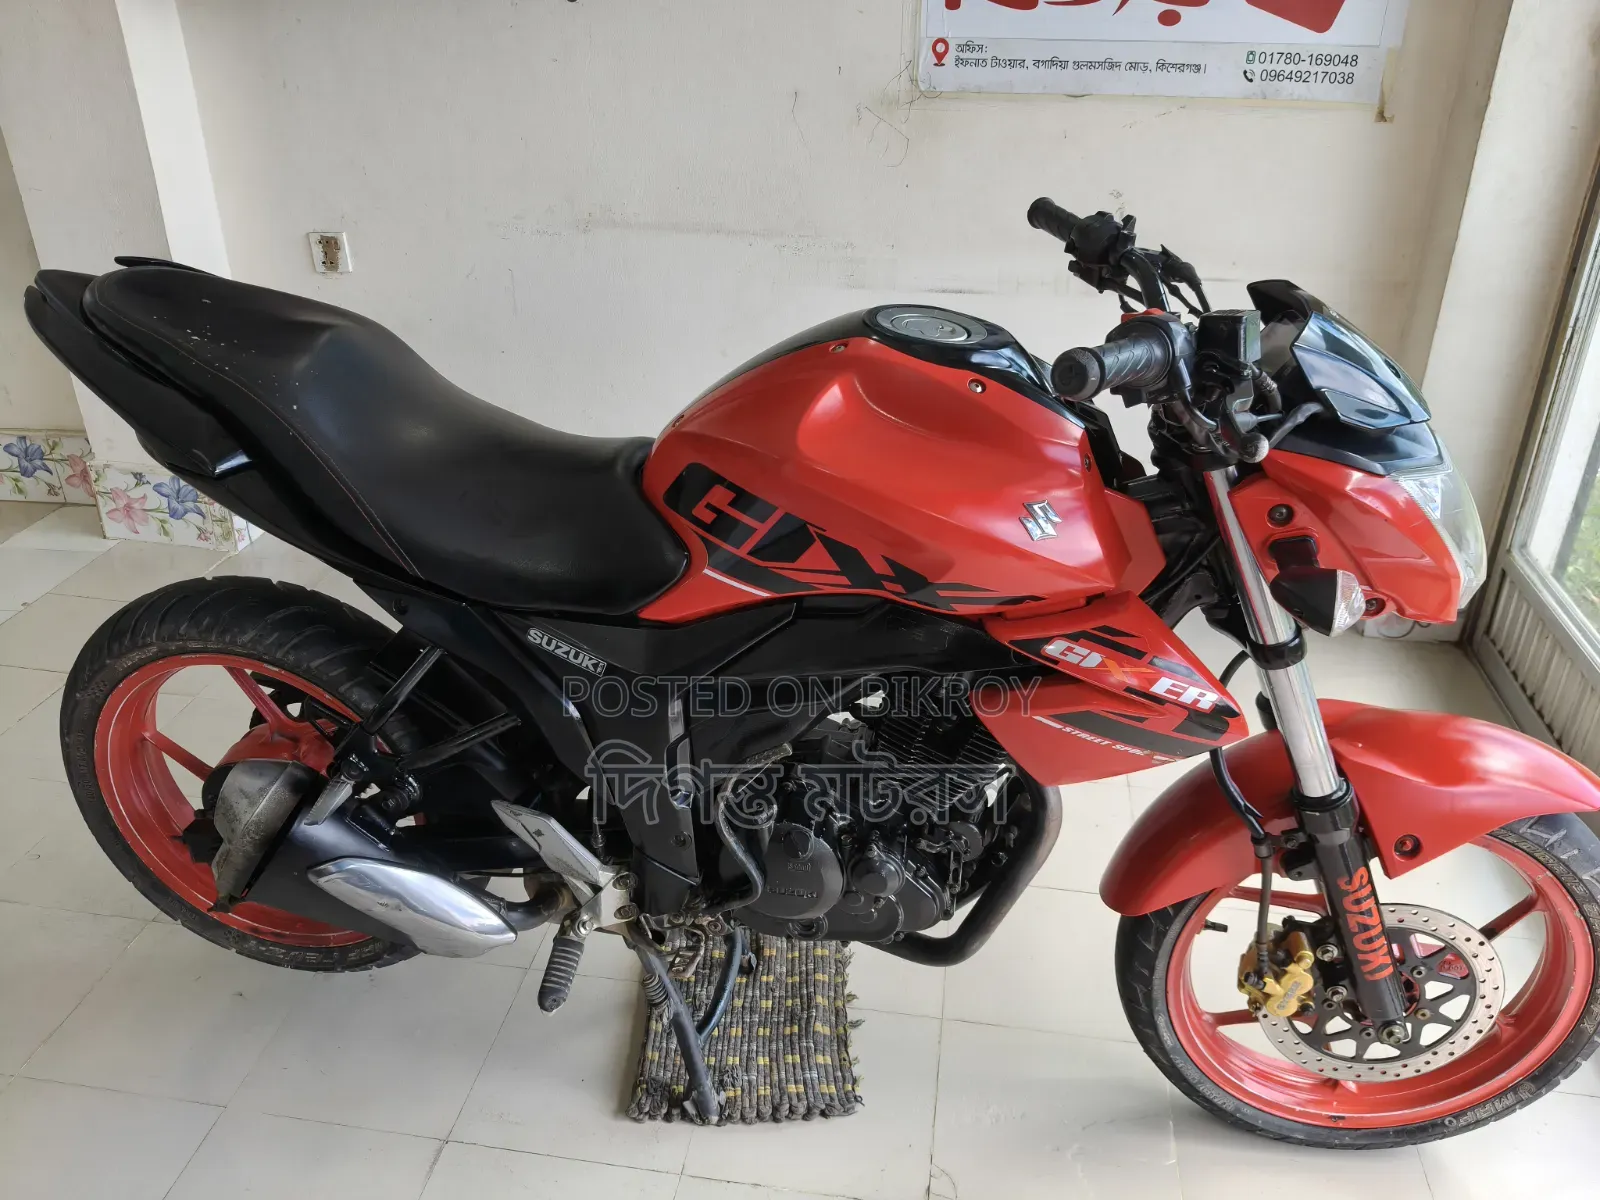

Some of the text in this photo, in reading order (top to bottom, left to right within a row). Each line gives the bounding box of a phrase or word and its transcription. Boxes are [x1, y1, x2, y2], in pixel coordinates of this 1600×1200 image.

[955, 40, 988, 54] অফিস:
[990, 55, 1029, 70] টাওয়ার,
[1258, 51, 1359, 67] 01780-169048
[1260, 69, 1355, 85] 09649217038
[527, 629, 605, 674] SUZUKI
[1062, 726, 1112, 746] STREET
[1337, 866, 1394, 982] SUZUKI
